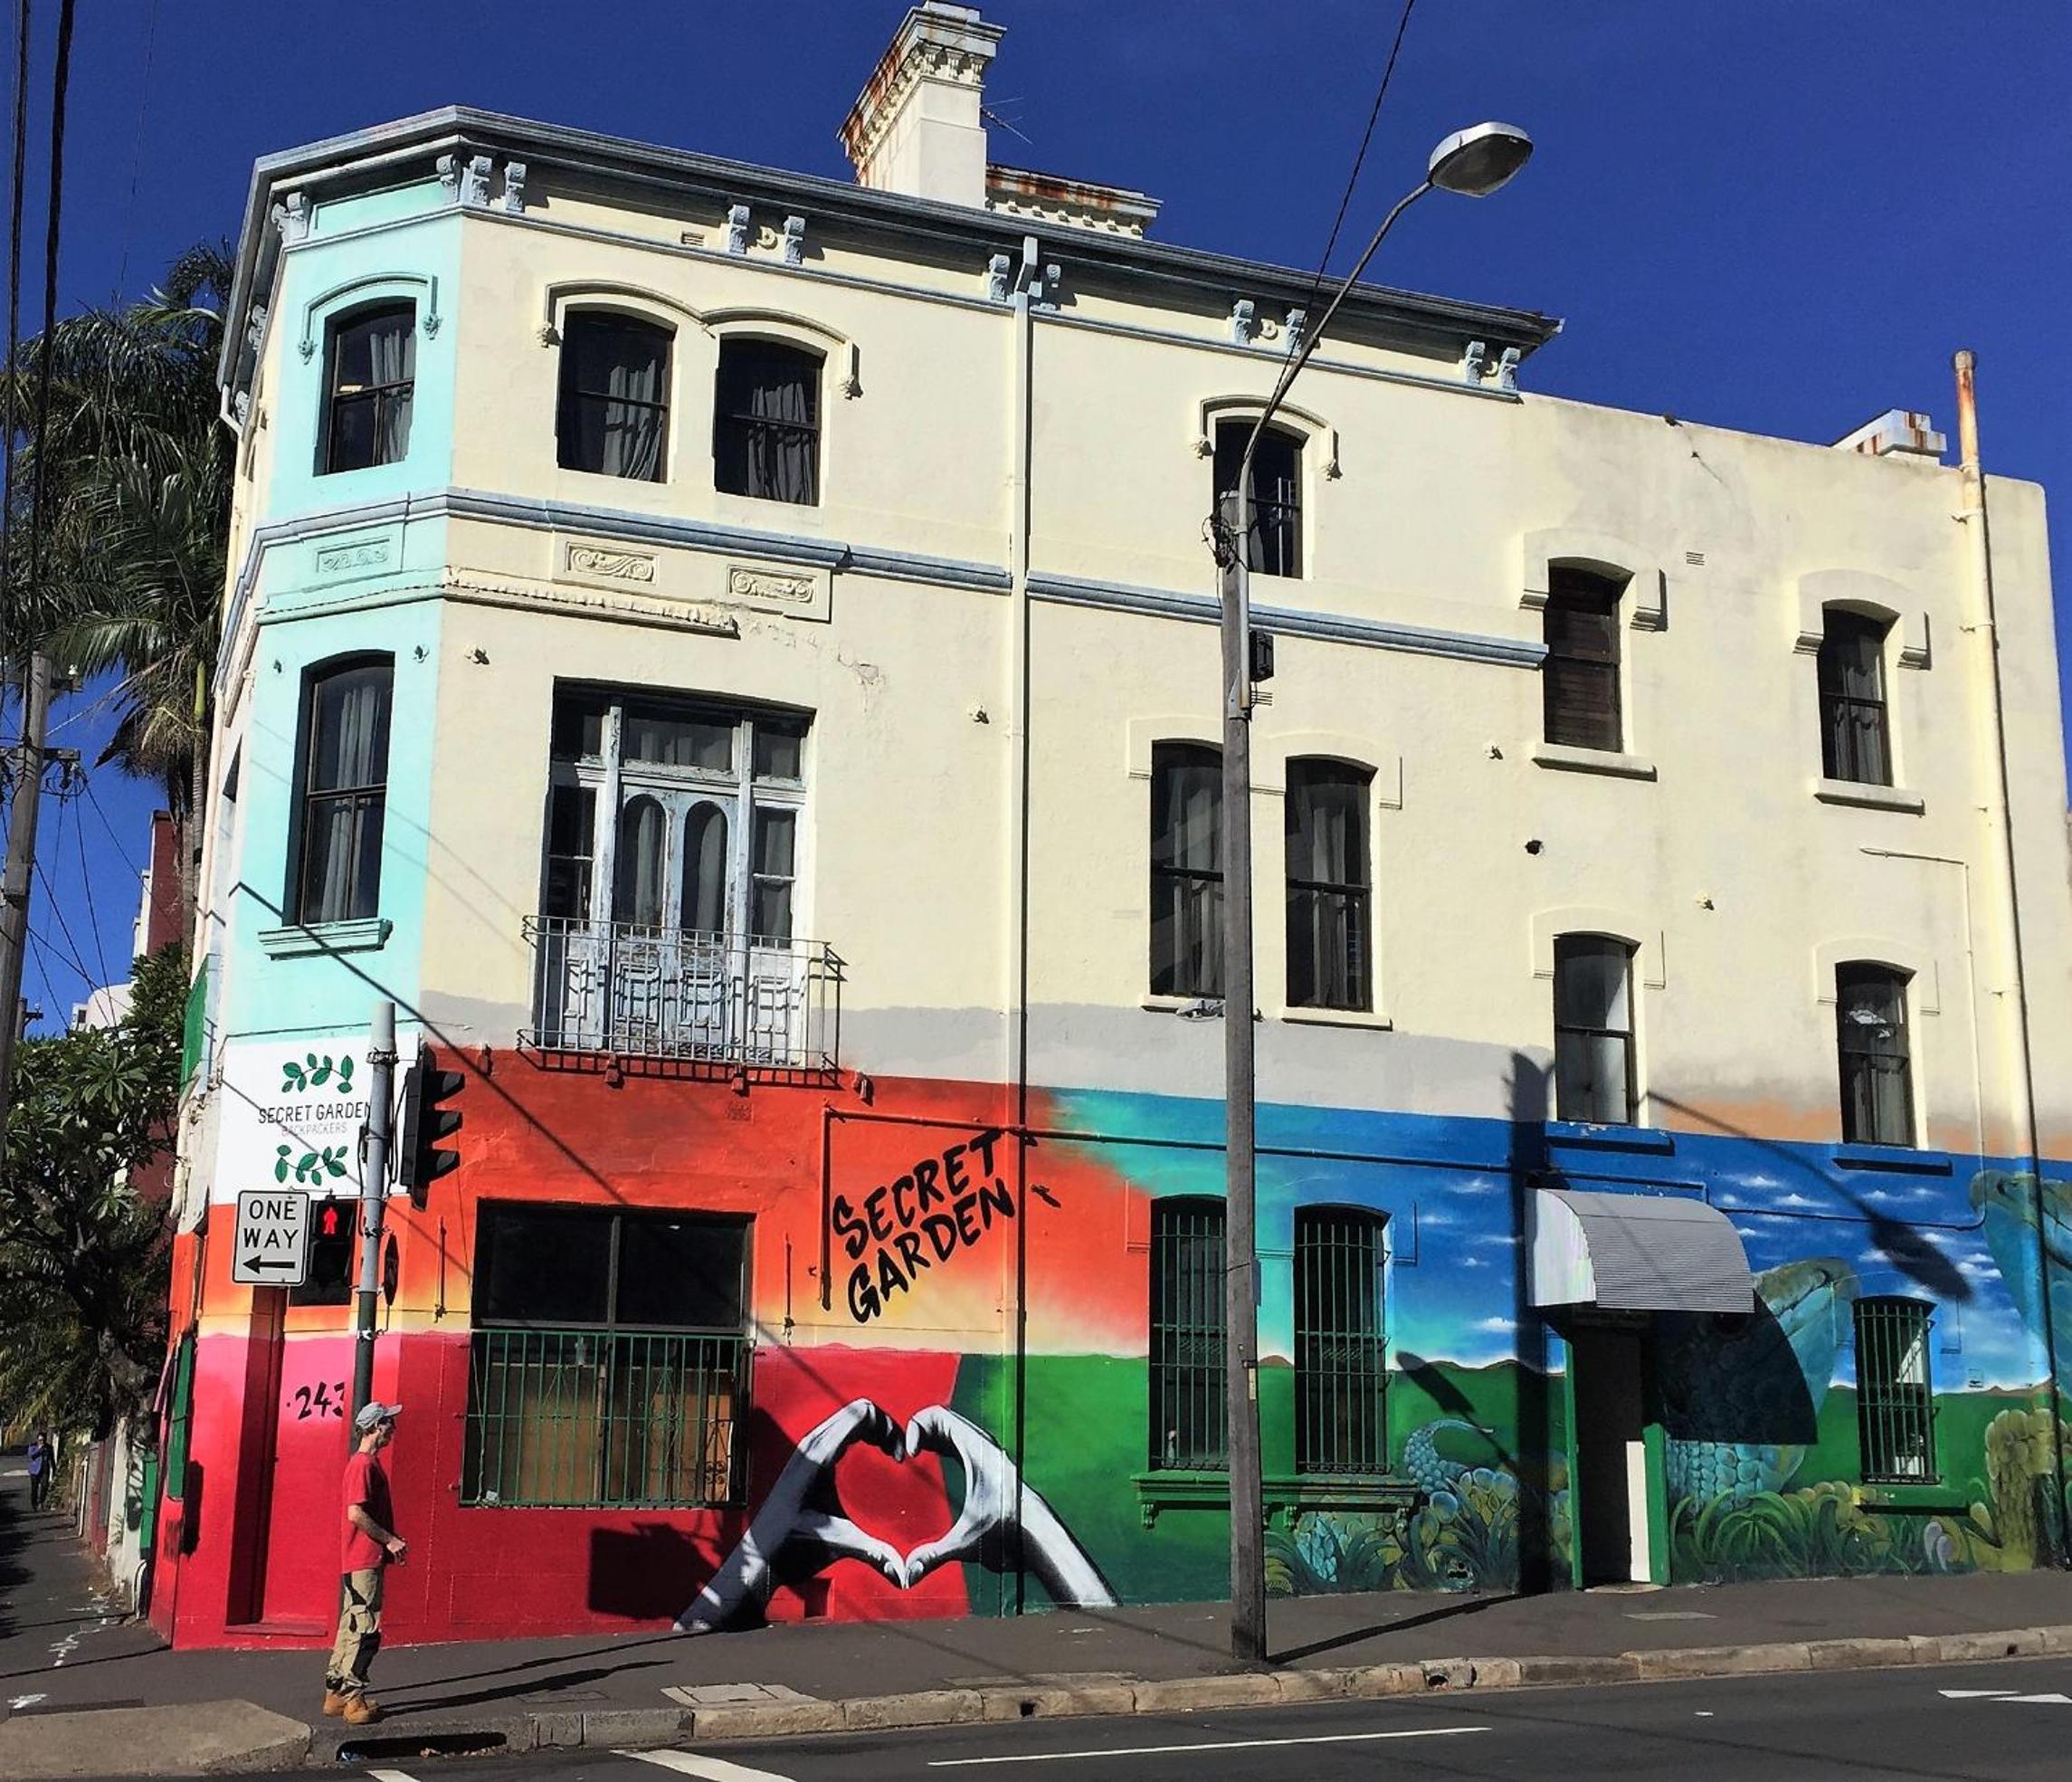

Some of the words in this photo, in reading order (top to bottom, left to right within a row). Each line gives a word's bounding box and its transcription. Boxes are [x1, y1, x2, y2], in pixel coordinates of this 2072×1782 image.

[258, 1105, 312, 1123] SECRET
[832, 1129, 1002, 1259] SECRET
[249, 1200, 297, 1220] ONE
[242, 1227, 299, 1249] WAY
[848, 1177, 1015, 1323] GARDEN
